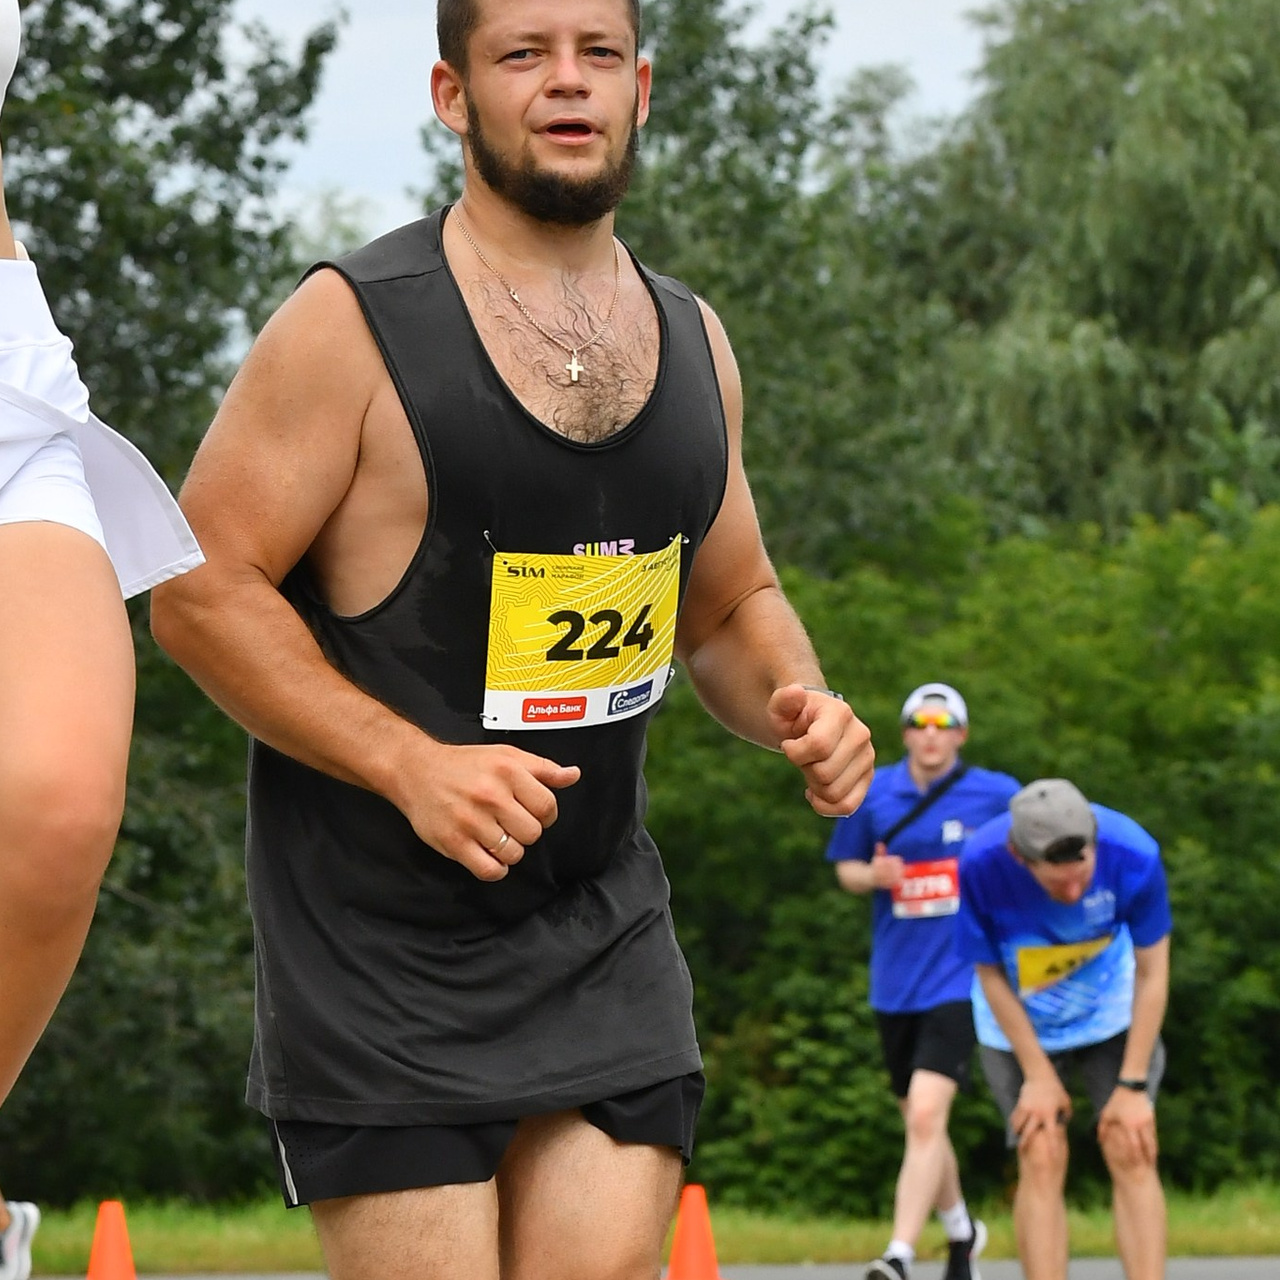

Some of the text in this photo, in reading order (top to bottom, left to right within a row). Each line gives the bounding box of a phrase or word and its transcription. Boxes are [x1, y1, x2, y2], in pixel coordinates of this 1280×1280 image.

[546, 604, 654, 662] 224
[527, 704, 582, 716] Альфа Банк
